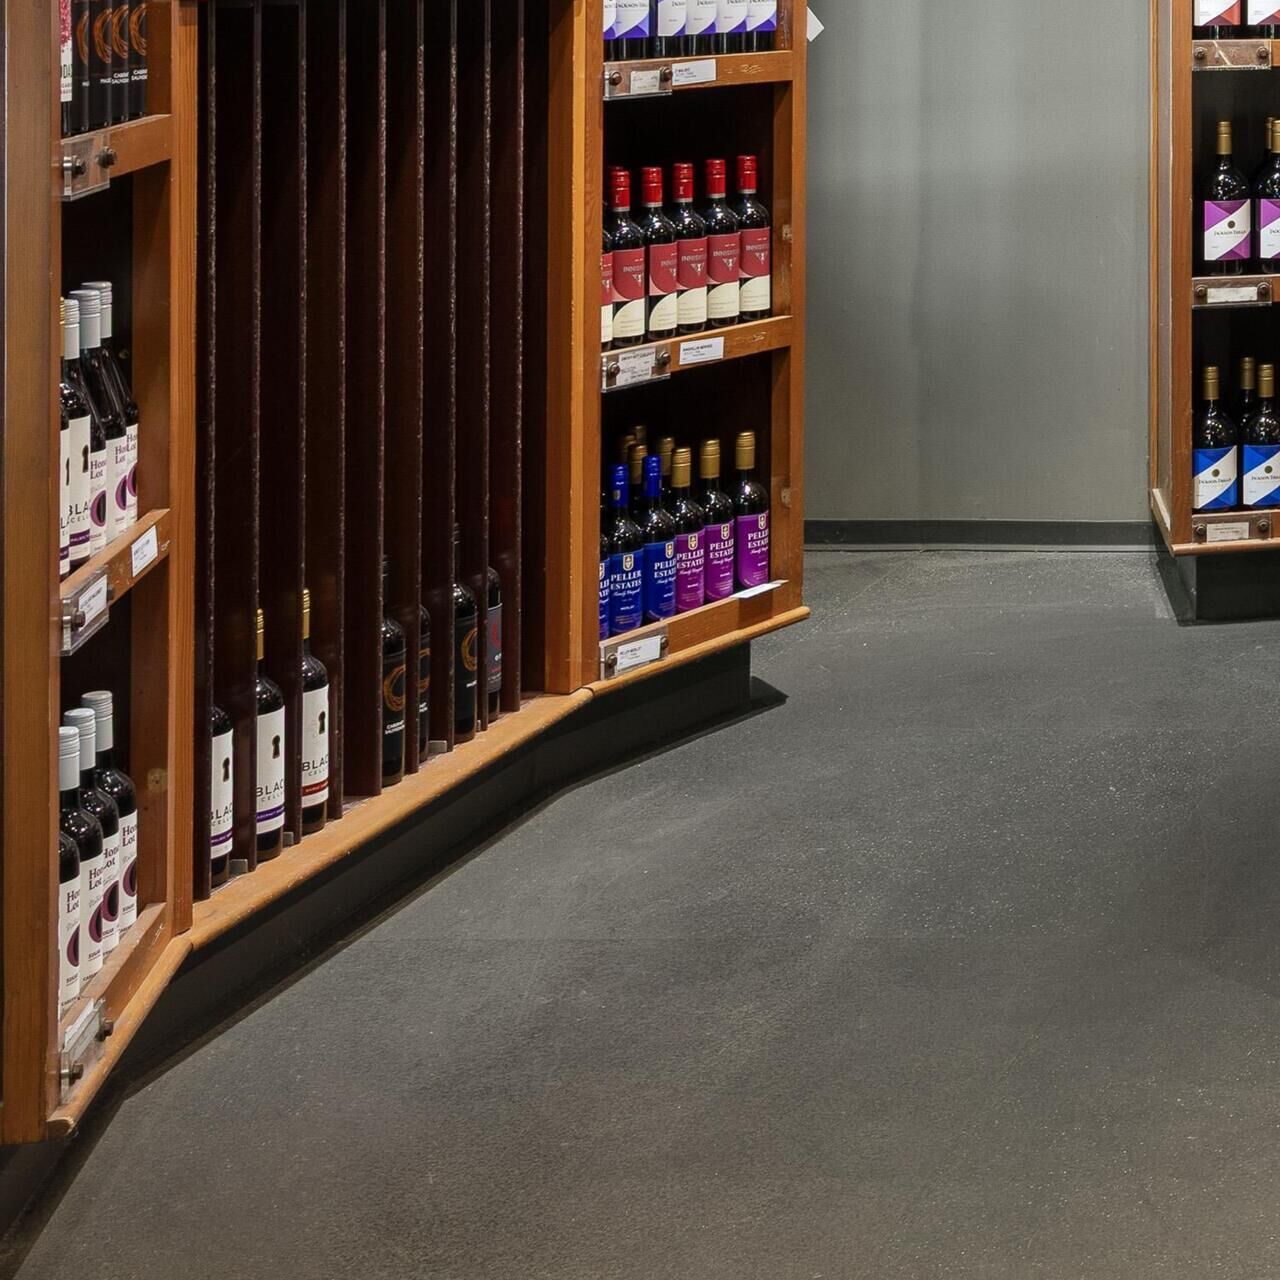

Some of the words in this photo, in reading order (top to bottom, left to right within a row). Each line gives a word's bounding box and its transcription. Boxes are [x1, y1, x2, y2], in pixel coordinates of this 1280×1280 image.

[610, 570, 642, 582] PELLER
[610, 578, 642, 591] ESTATES
[122, 834, 136, 848] Lot
[88, 878, 102, 892] Lot
[66, 901, 80, 915] Lot
